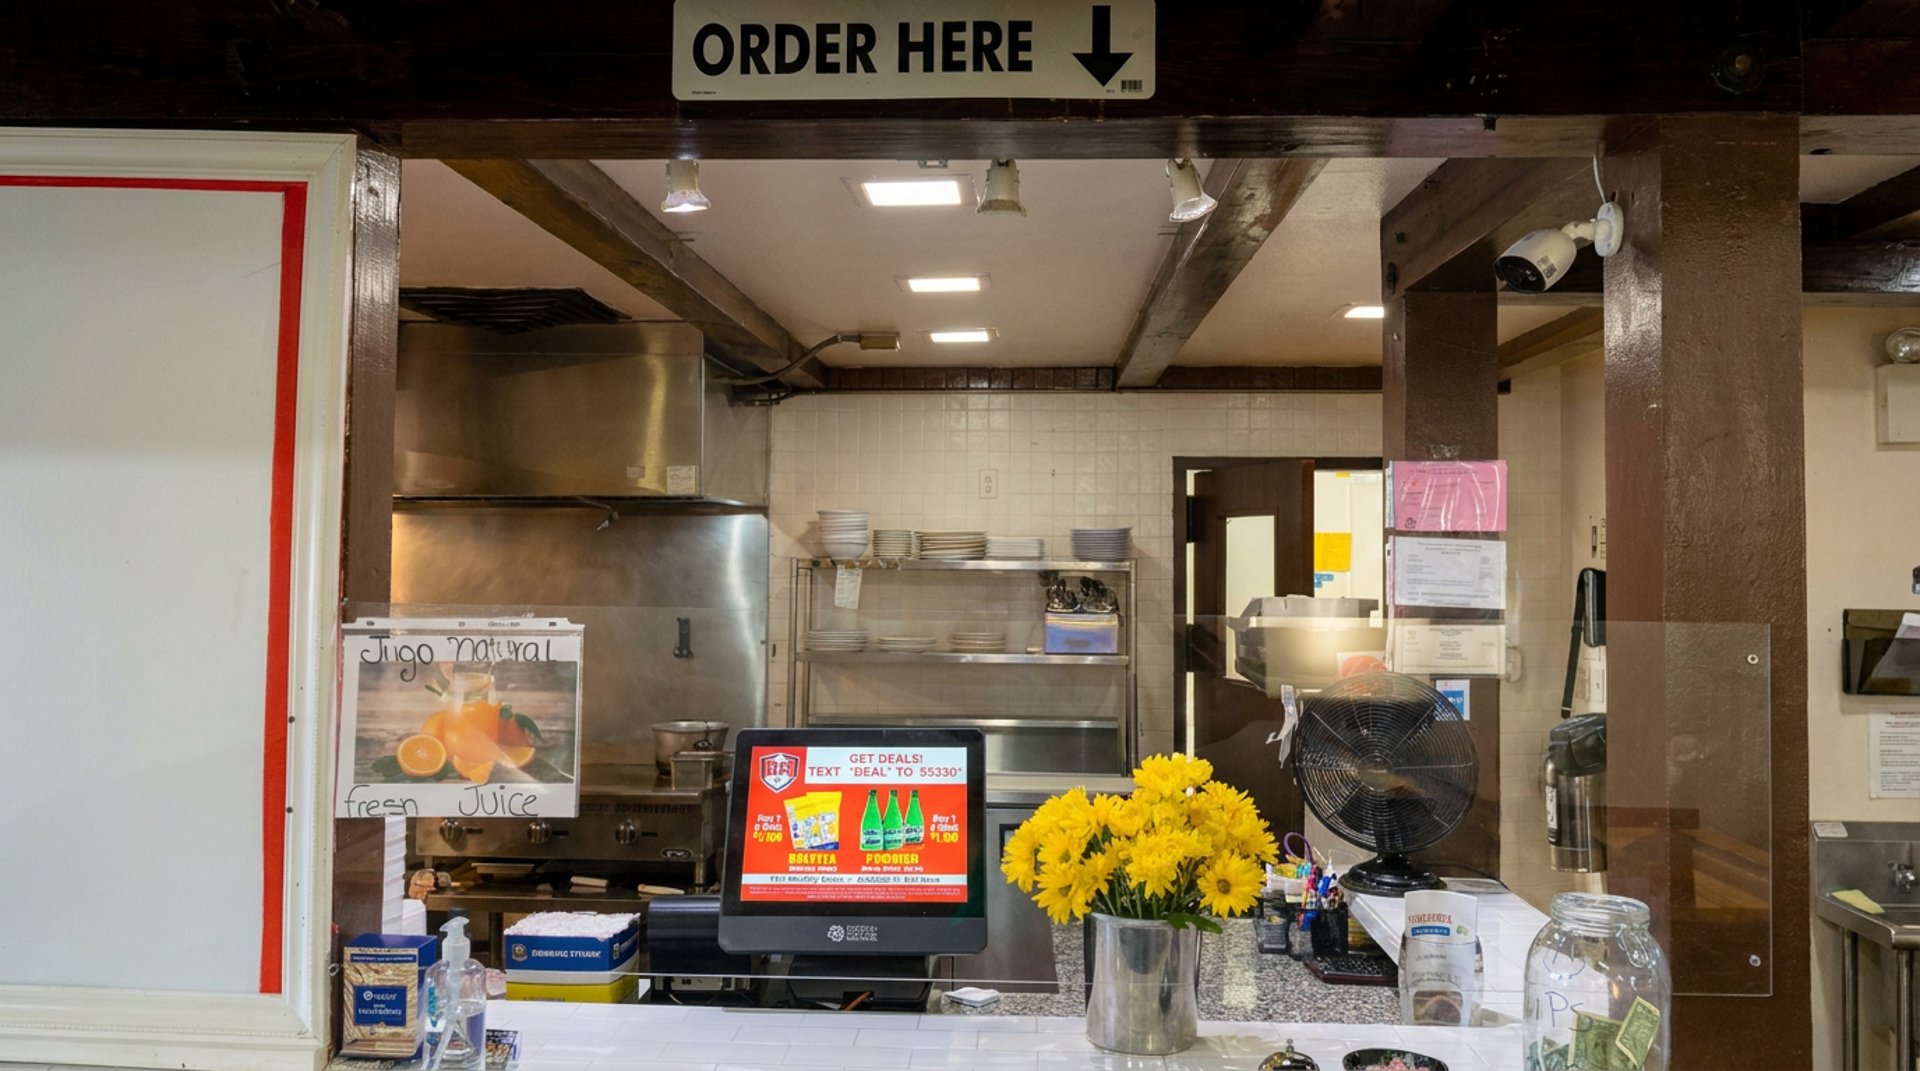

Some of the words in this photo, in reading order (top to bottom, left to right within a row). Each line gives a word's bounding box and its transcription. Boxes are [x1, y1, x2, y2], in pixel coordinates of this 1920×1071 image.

[692, 22, 878, 77] ORDER
[897, 19, 1034, 74] HERE
[849, 753, 875, 764] GET
[878, 753, 924, 764] DEALS!
[807, 765, 841, 777] TEXT
[896, 767, 914, 777] TO
[458, 783, 539, 817] Juice
